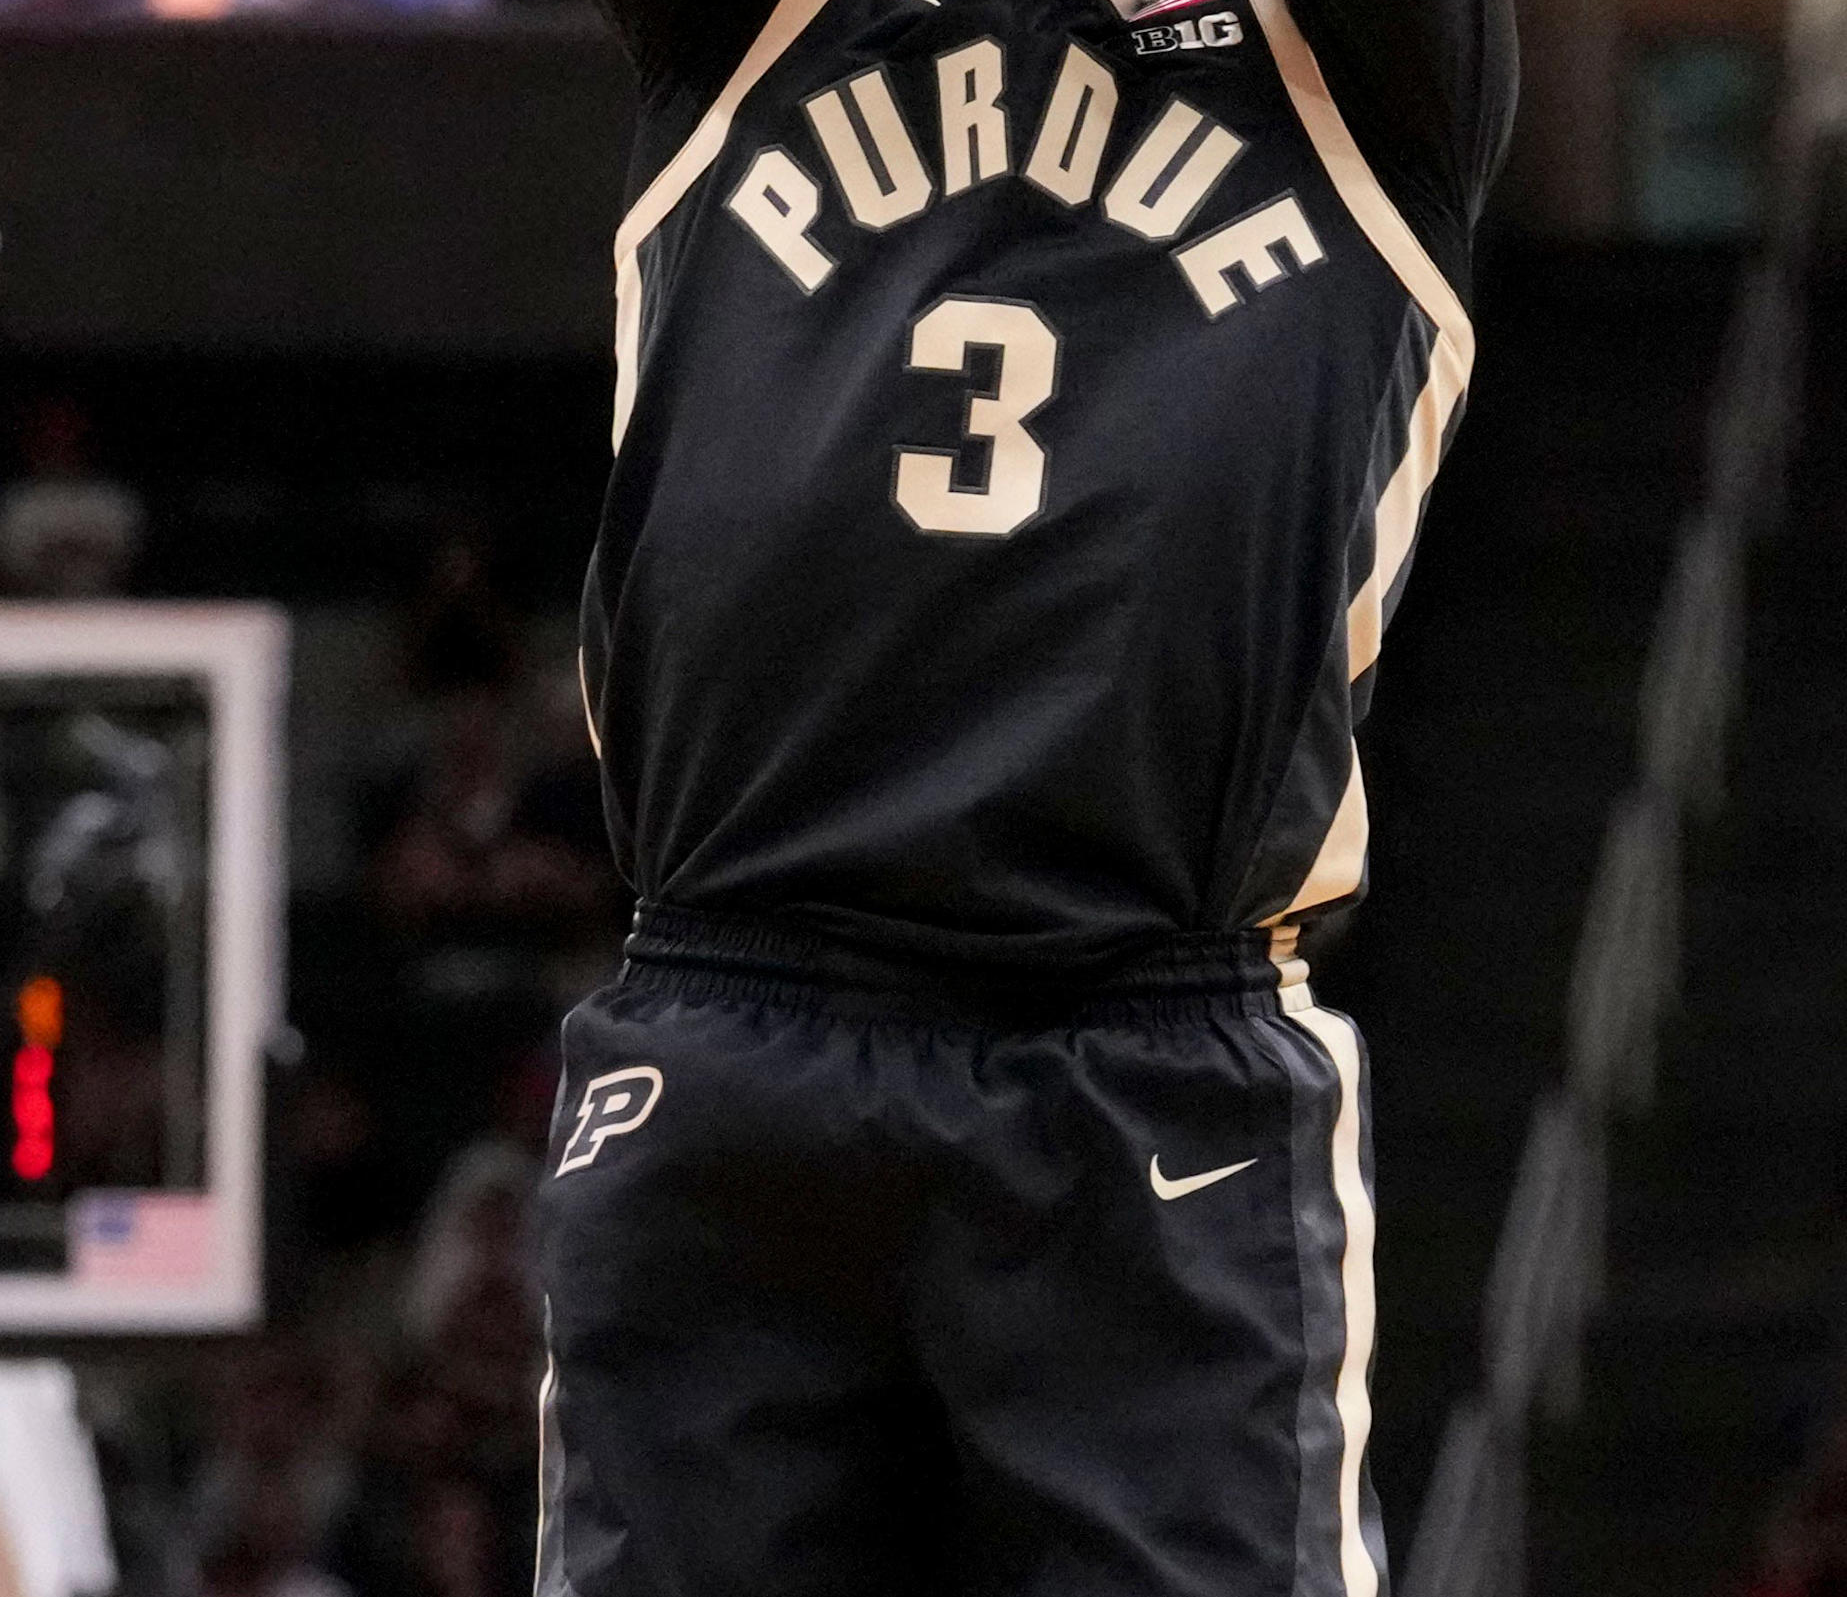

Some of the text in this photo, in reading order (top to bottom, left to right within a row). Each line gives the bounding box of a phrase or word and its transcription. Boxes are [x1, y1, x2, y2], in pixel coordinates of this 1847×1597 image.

[724, 34, 1330, 321] PURDUE
[892, 293, 1064, 540] 3
[554, 1065, 664, 1179] P
